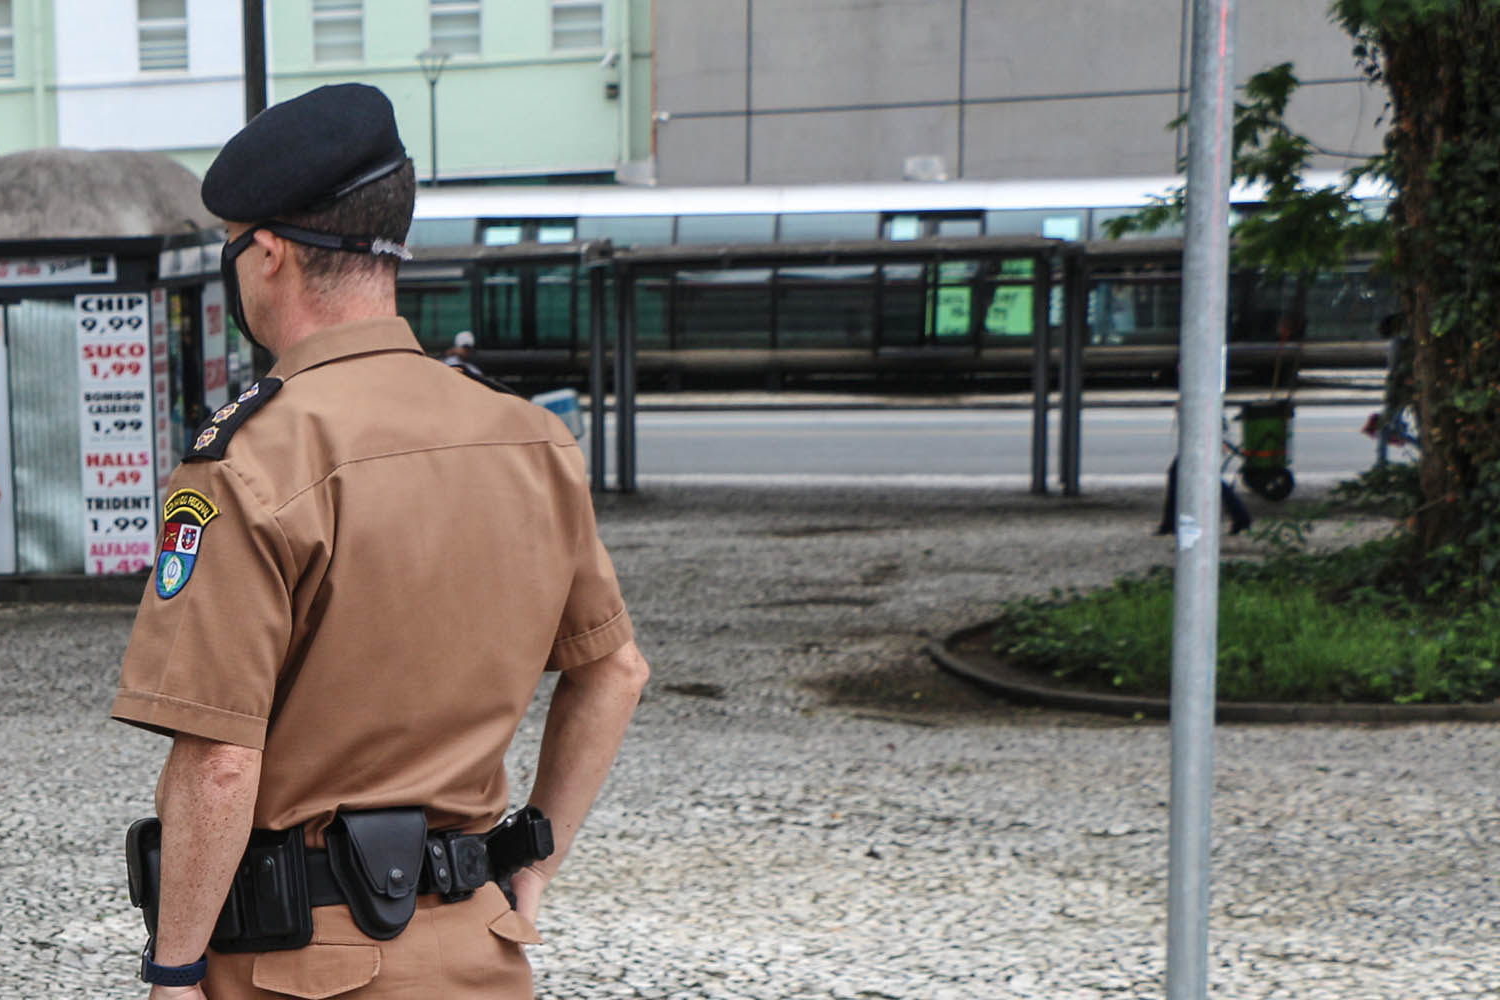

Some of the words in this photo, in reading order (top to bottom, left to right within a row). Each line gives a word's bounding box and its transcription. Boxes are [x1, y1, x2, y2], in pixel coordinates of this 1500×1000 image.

[81, 297, 143, 311] CHIP
[81, 316, 142, 334] 9,99
[83, 343, 145, 358] SUCO
[91, 362, 141, 380] 1,99
[93, 420, 142, 435] 1,99
[86, 452, 149, 467] HALLS
[97, 471, 142, 488] 1,49
[86, 497, 151, 510] TRIDENT
[90, 516, 148, 534] 1,99
[90, 542, 150, 556] ALFAJOR
